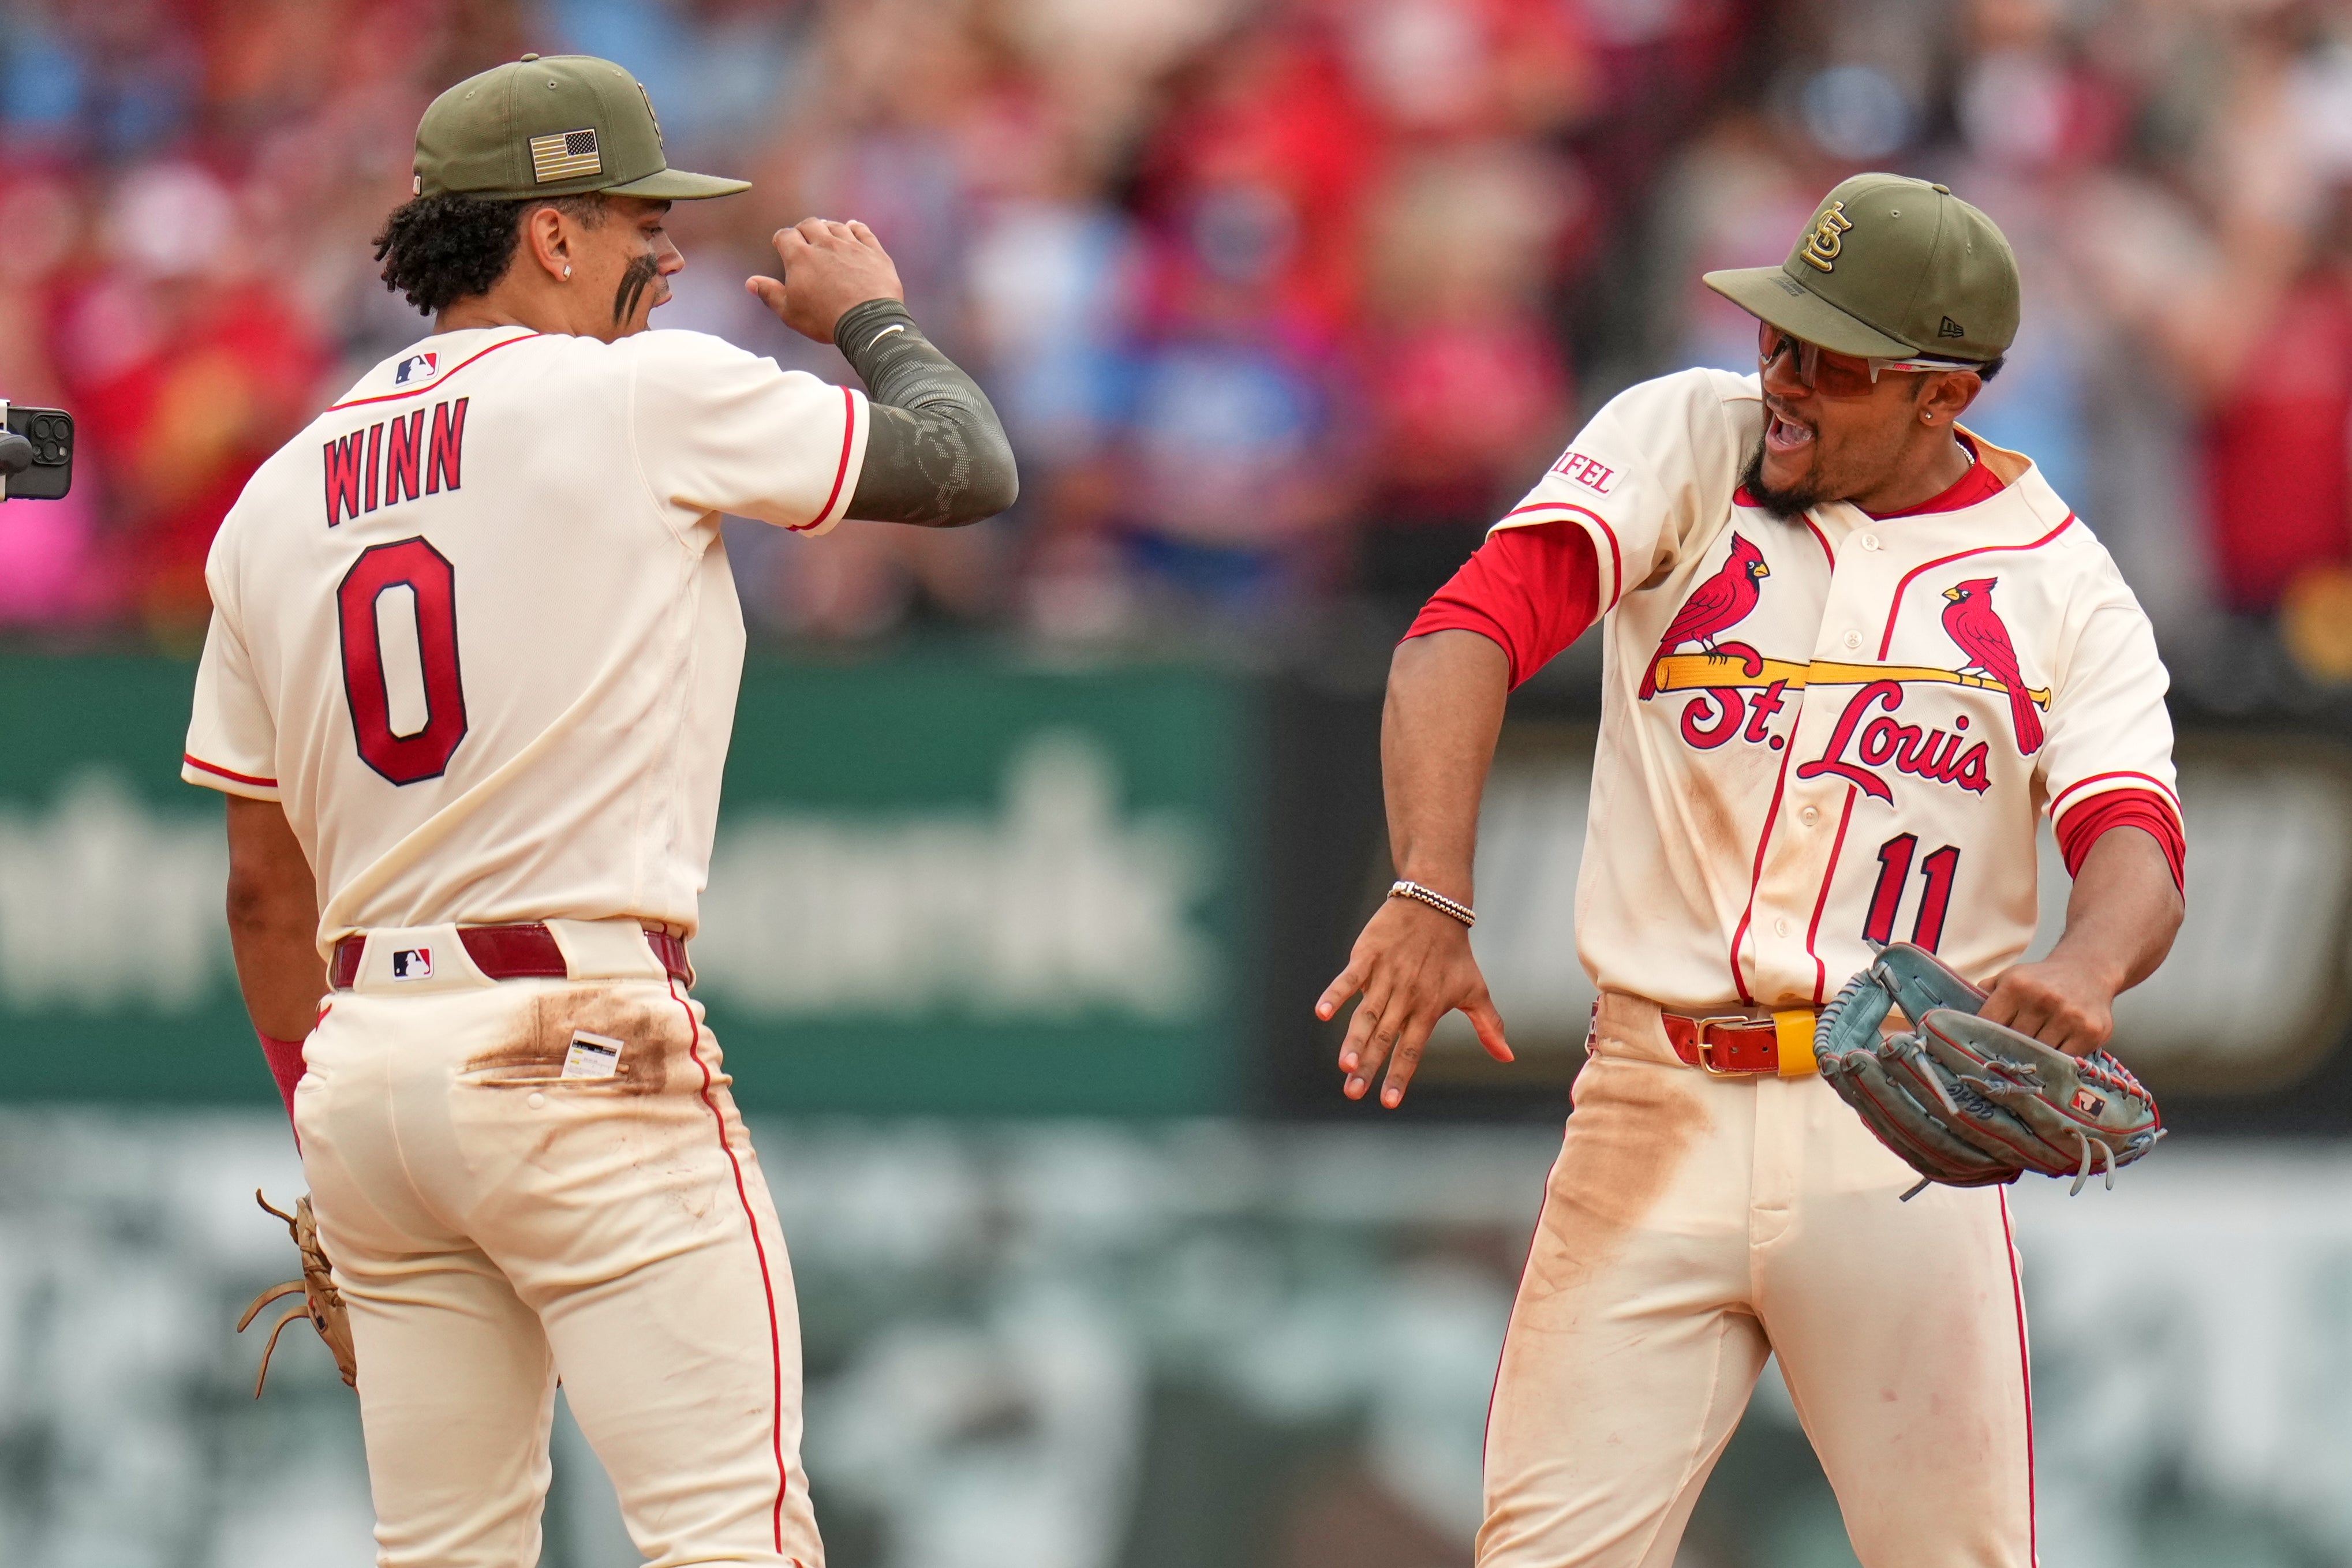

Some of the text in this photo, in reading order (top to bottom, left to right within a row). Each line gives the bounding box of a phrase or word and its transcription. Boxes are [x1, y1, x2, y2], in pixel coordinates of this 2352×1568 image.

[323, 396, 469, 528] WINN
[337, 534, 469, 787] 0
[1680, 641, 1992, 808] St. Louis
[1861, 832, 1961, 956] 11
